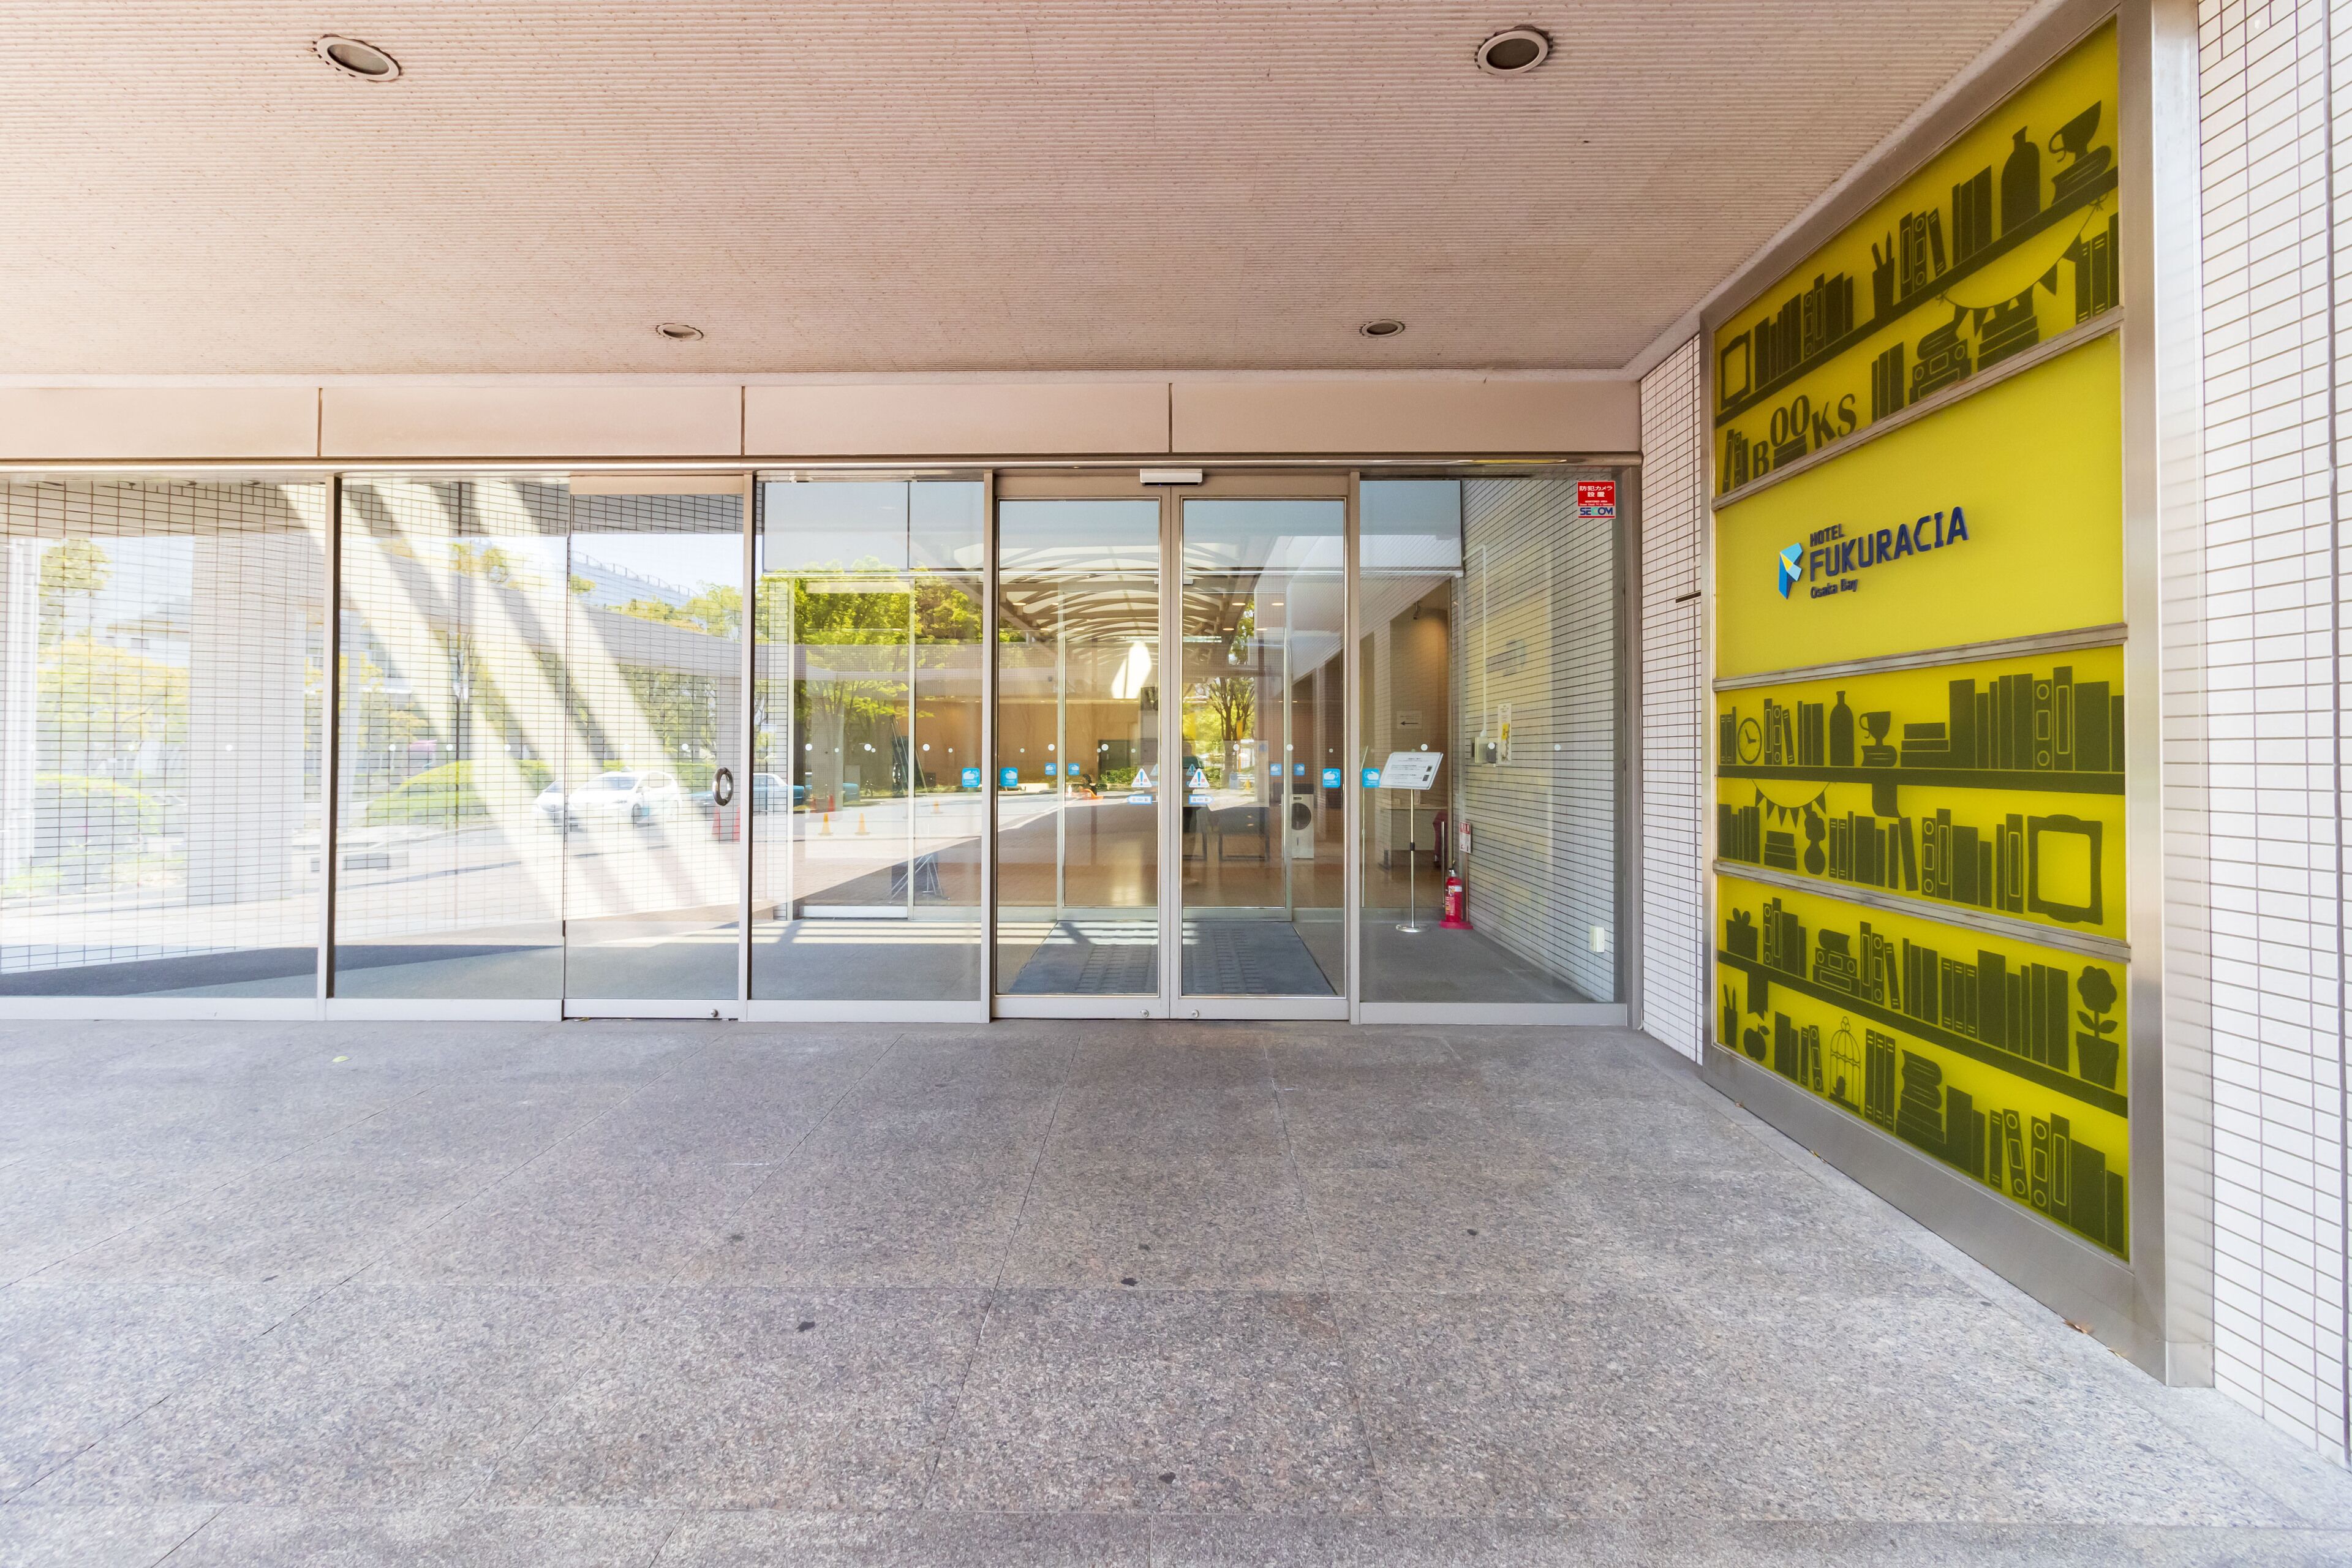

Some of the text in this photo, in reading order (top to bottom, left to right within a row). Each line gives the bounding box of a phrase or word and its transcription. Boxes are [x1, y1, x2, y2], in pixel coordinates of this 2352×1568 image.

[1753, 393, 1856, 479] BOOKS
[1810, 523, 1845, 547] HOTEL
[1810, 506, 1969, 582] FUKURACIA
[1810, 578, 1858, 599] Osaka Bay
